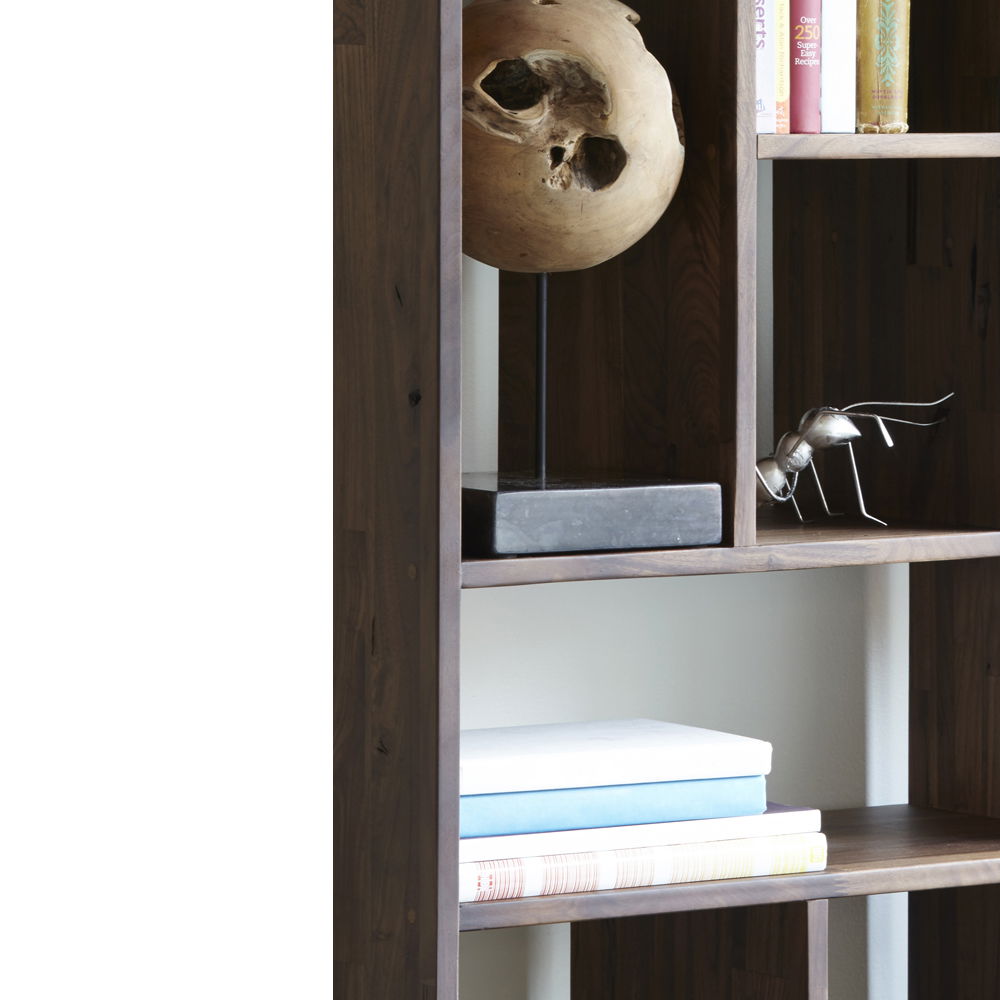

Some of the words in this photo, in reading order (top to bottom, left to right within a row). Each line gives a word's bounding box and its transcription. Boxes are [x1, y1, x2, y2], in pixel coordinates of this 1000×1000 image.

[799, 16, 817, 24] Over
[794, 24, 820, 40] 250
[800, 49, 817, 58] Easy
